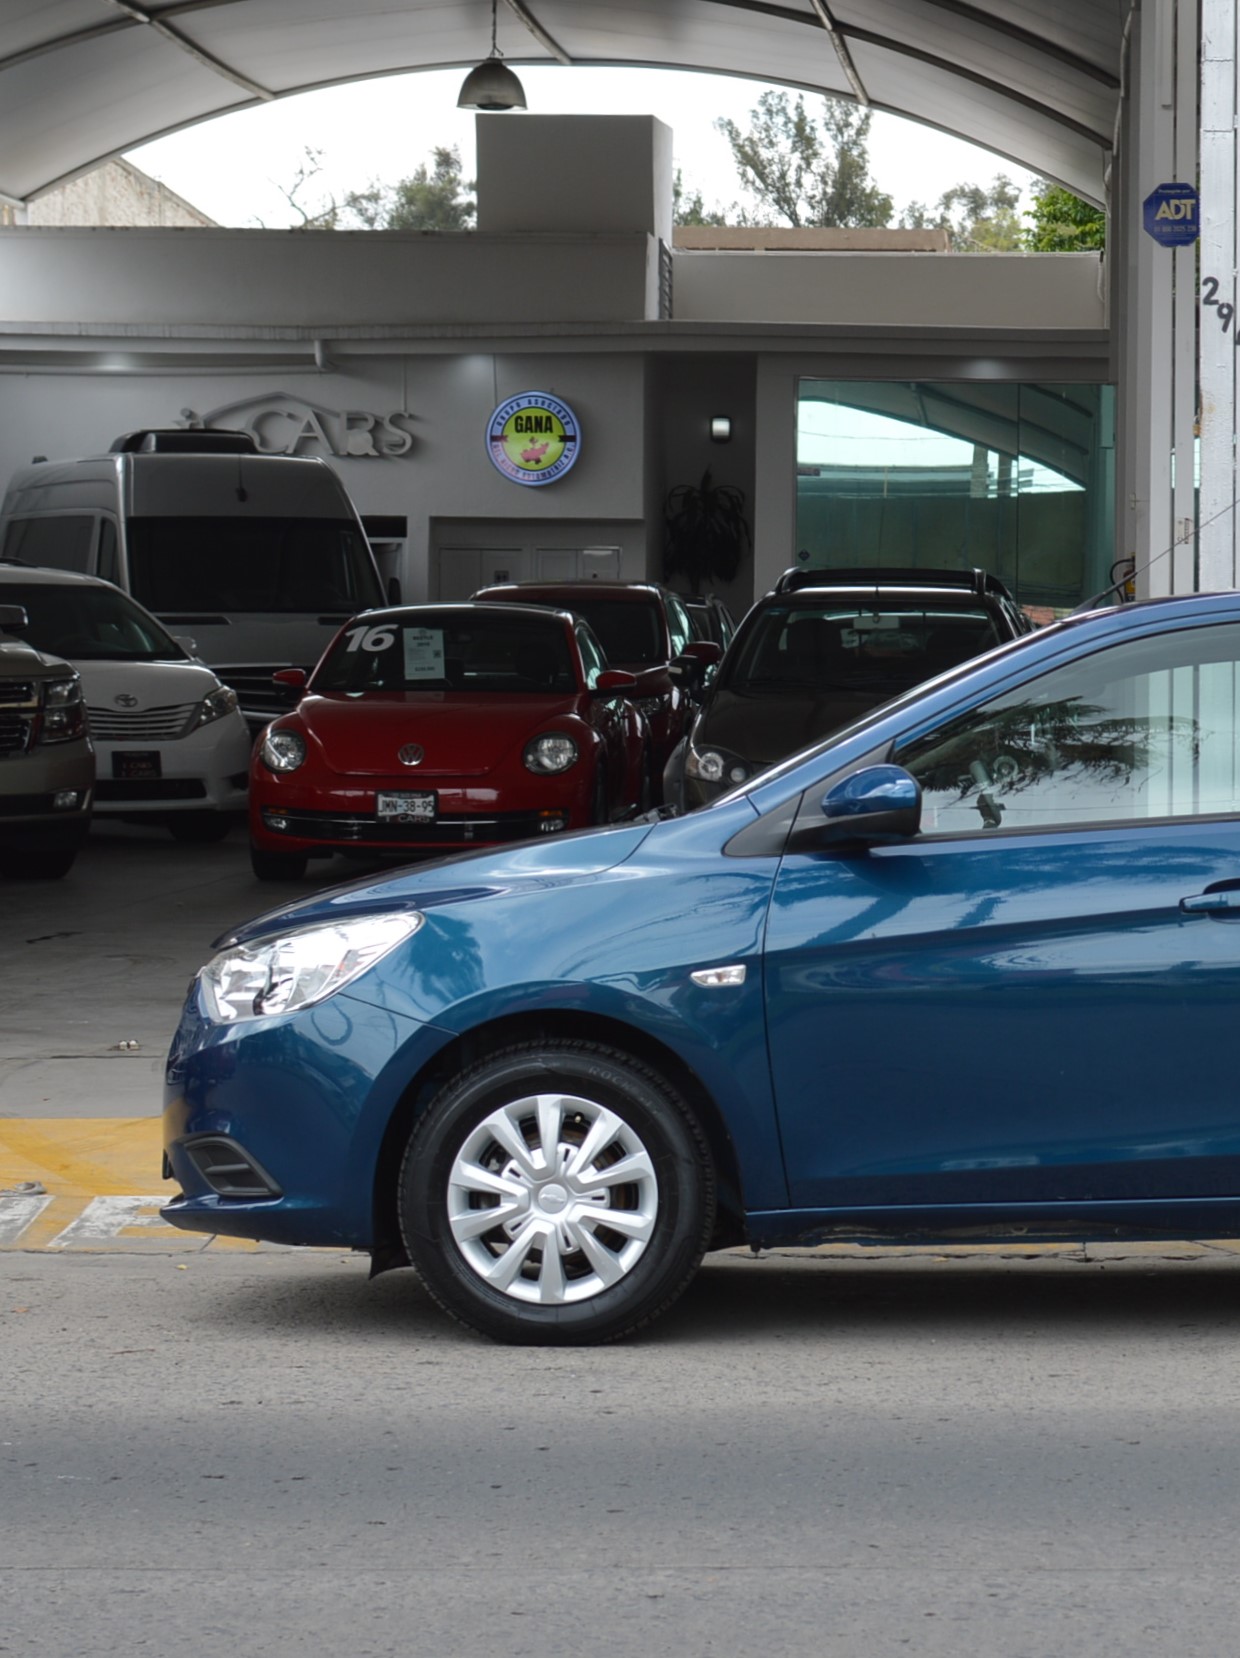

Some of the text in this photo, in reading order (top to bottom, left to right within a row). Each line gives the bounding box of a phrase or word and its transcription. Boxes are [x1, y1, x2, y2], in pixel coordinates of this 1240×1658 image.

[1155, 199, 1196, 220] ADT
[247, 408, 413, 457] CARS
[514, 415, 553, 433] GANA
[345, 624, 399, 652] 16
